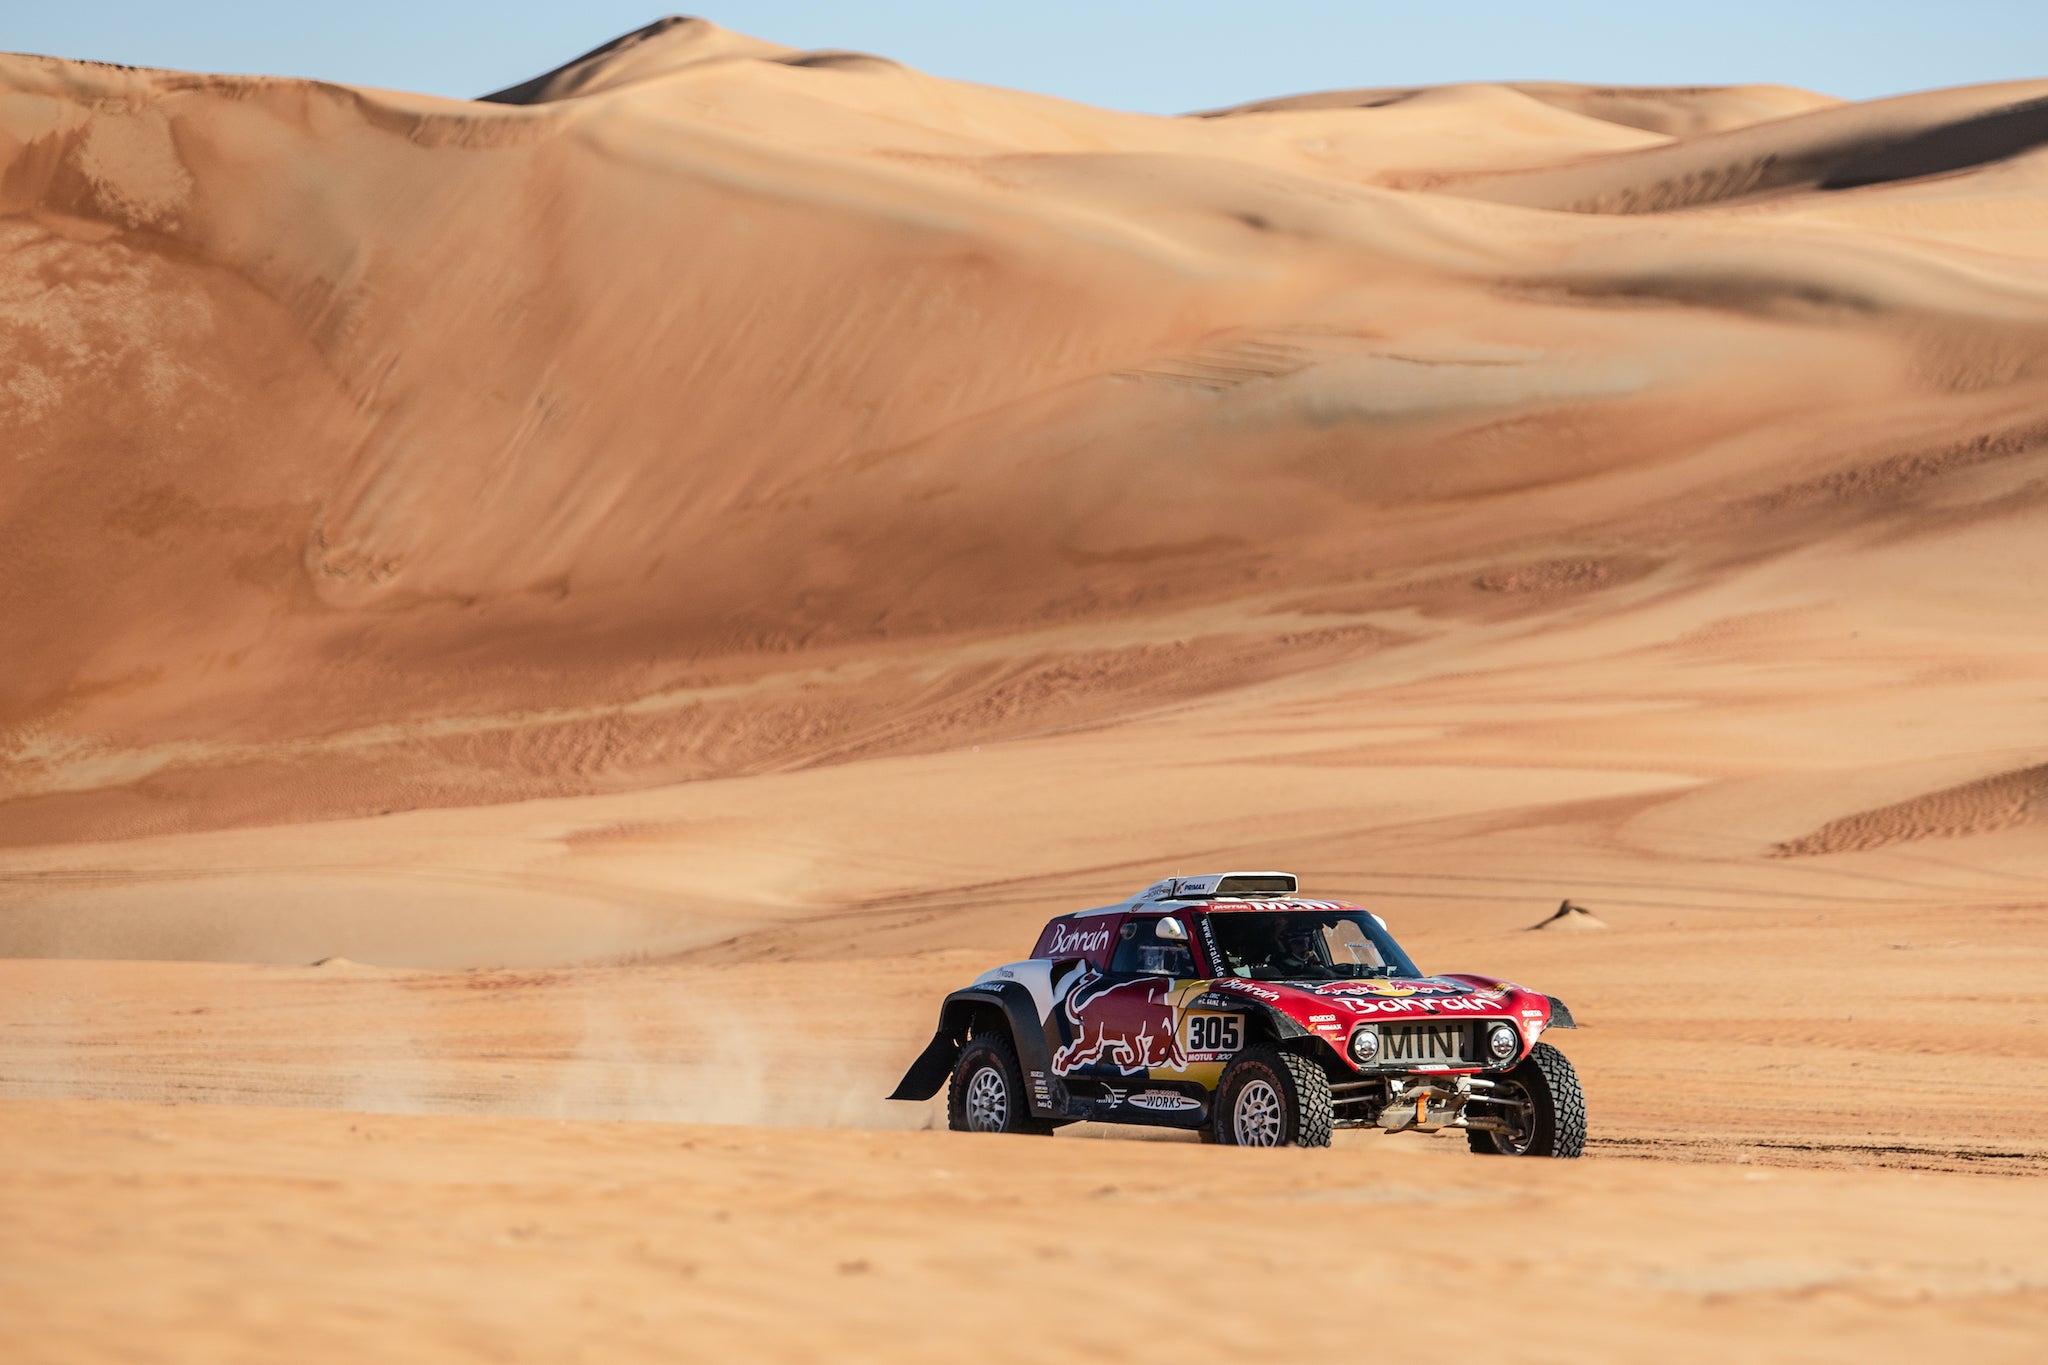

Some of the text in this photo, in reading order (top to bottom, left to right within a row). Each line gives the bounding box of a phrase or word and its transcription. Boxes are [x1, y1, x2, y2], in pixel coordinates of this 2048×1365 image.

[1048, 922, 1110, 954] Bahrain
[1201, 918, 1225, 978] www.x-raid.de
[1220, 979, 1281, 1002] Bahrain
[1333, 996, 1502, 1014] Bahrain
[1190, 1016, 1239, 1050] 305
[1382, 1025, 1465, 1060] MINI
[1188, 1053, 1214, 1062] MOTUL
[1146, 1096, 1181, 1109] WORKS
